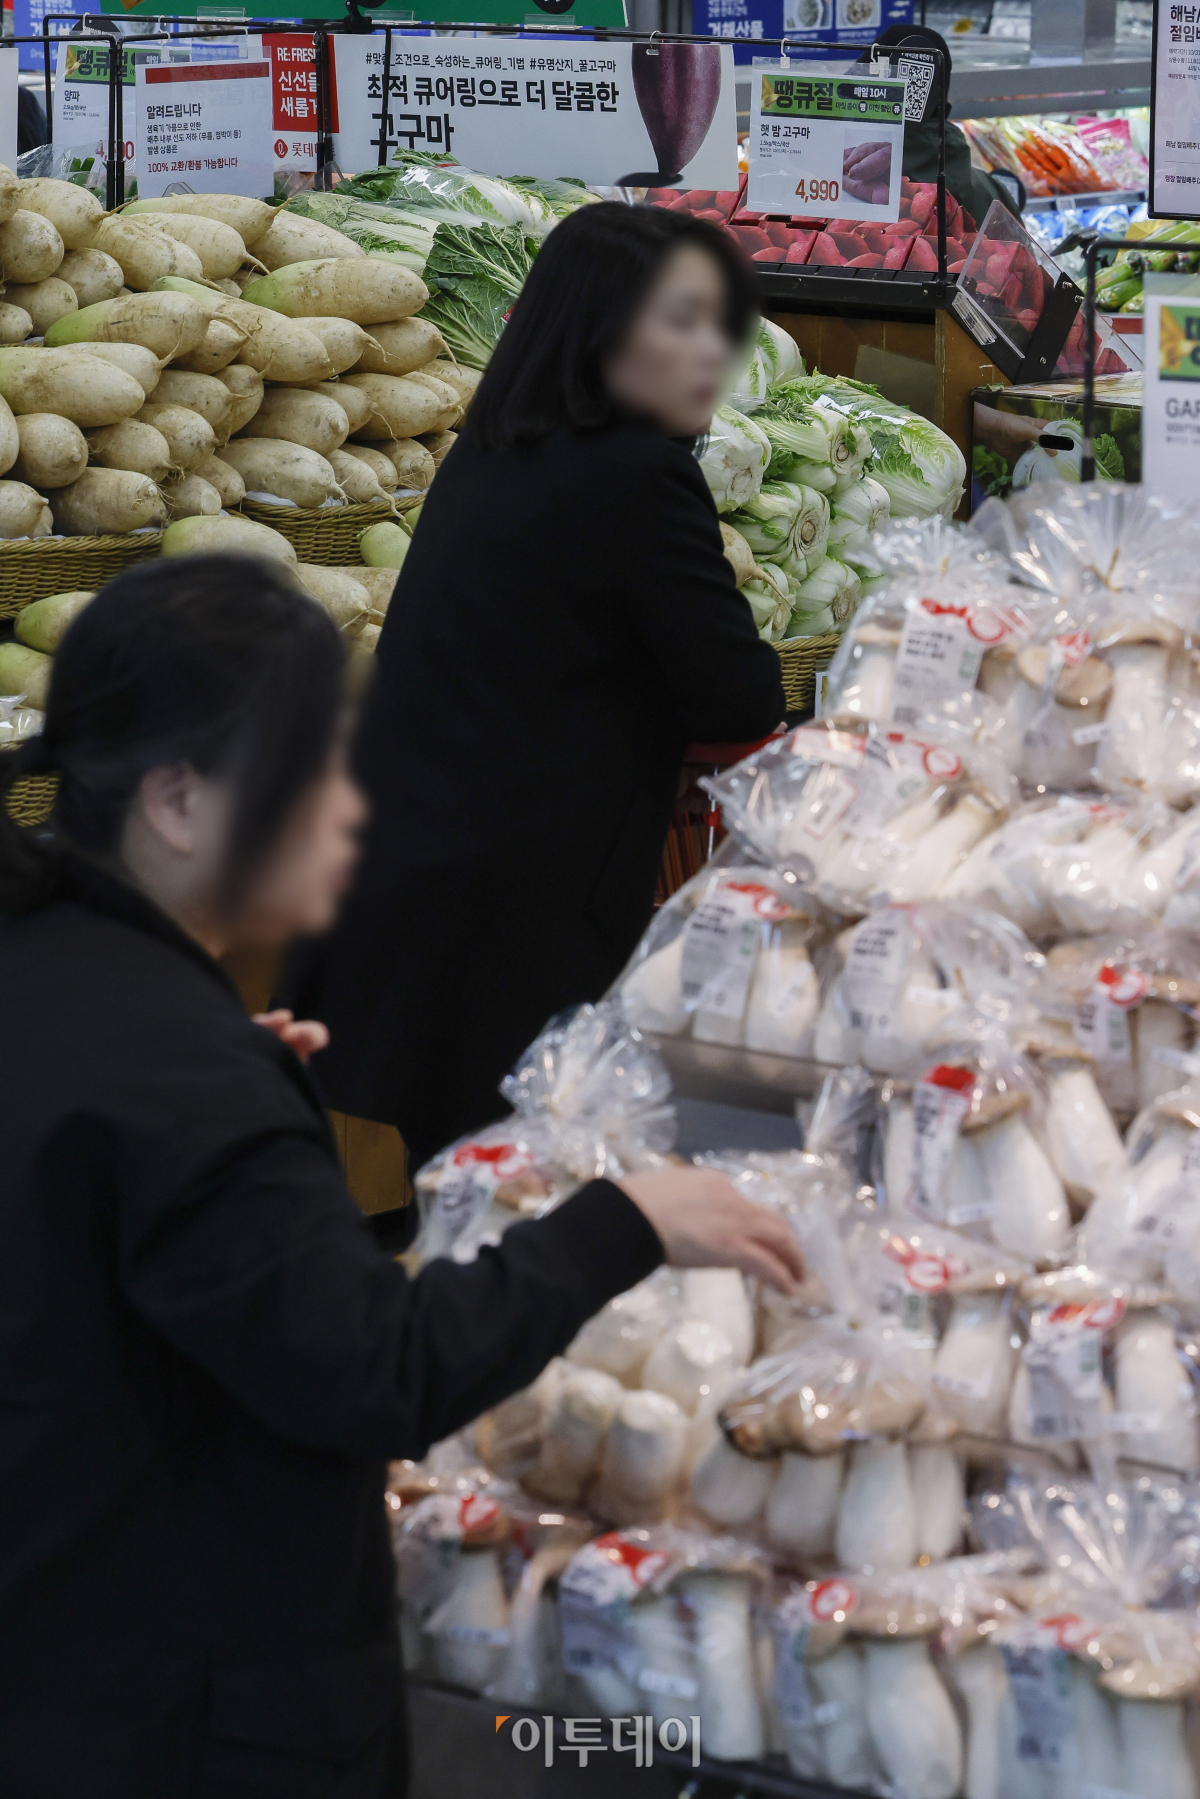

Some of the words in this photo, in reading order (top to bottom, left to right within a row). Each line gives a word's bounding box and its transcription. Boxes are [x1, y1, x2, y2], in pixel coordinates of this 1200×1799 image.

[529, 58, 617, 73] #유명산지_꿀고구마
[64, 90, 80, 102] 양파
[367, 74, 408, 105] 최적
[413, 76, 522, 108] 큐어링으로
[526, 80, 546, 111] 더
[552, 80, 620, 112] 달콤한
[774, 79, 834, 111] 땡큐절
[853, 87, 869, 98] 매일
[869, 88, 887, 99] 10시
[146, 102, 202, 120] 알려드립니다
[190, 122, 202, 131] 인한
[370, 113, 455, 153] 고구마
[760, 123, 770, 137] 햇
[772, 125, 782, 138] 밤
[783, 126, 811, 140] 고구마
[173, 134, 185, 143] 선도
[185, 133, 198, 142] 저하
[160, 144, 178, 154] 상품은
[148, 162, 169, 173] 100%
[171, 160, 202, 172] 교환/환불
[204, 157, 238, 170] 가능합니다
[795, 178, 839, 203] 4,990
